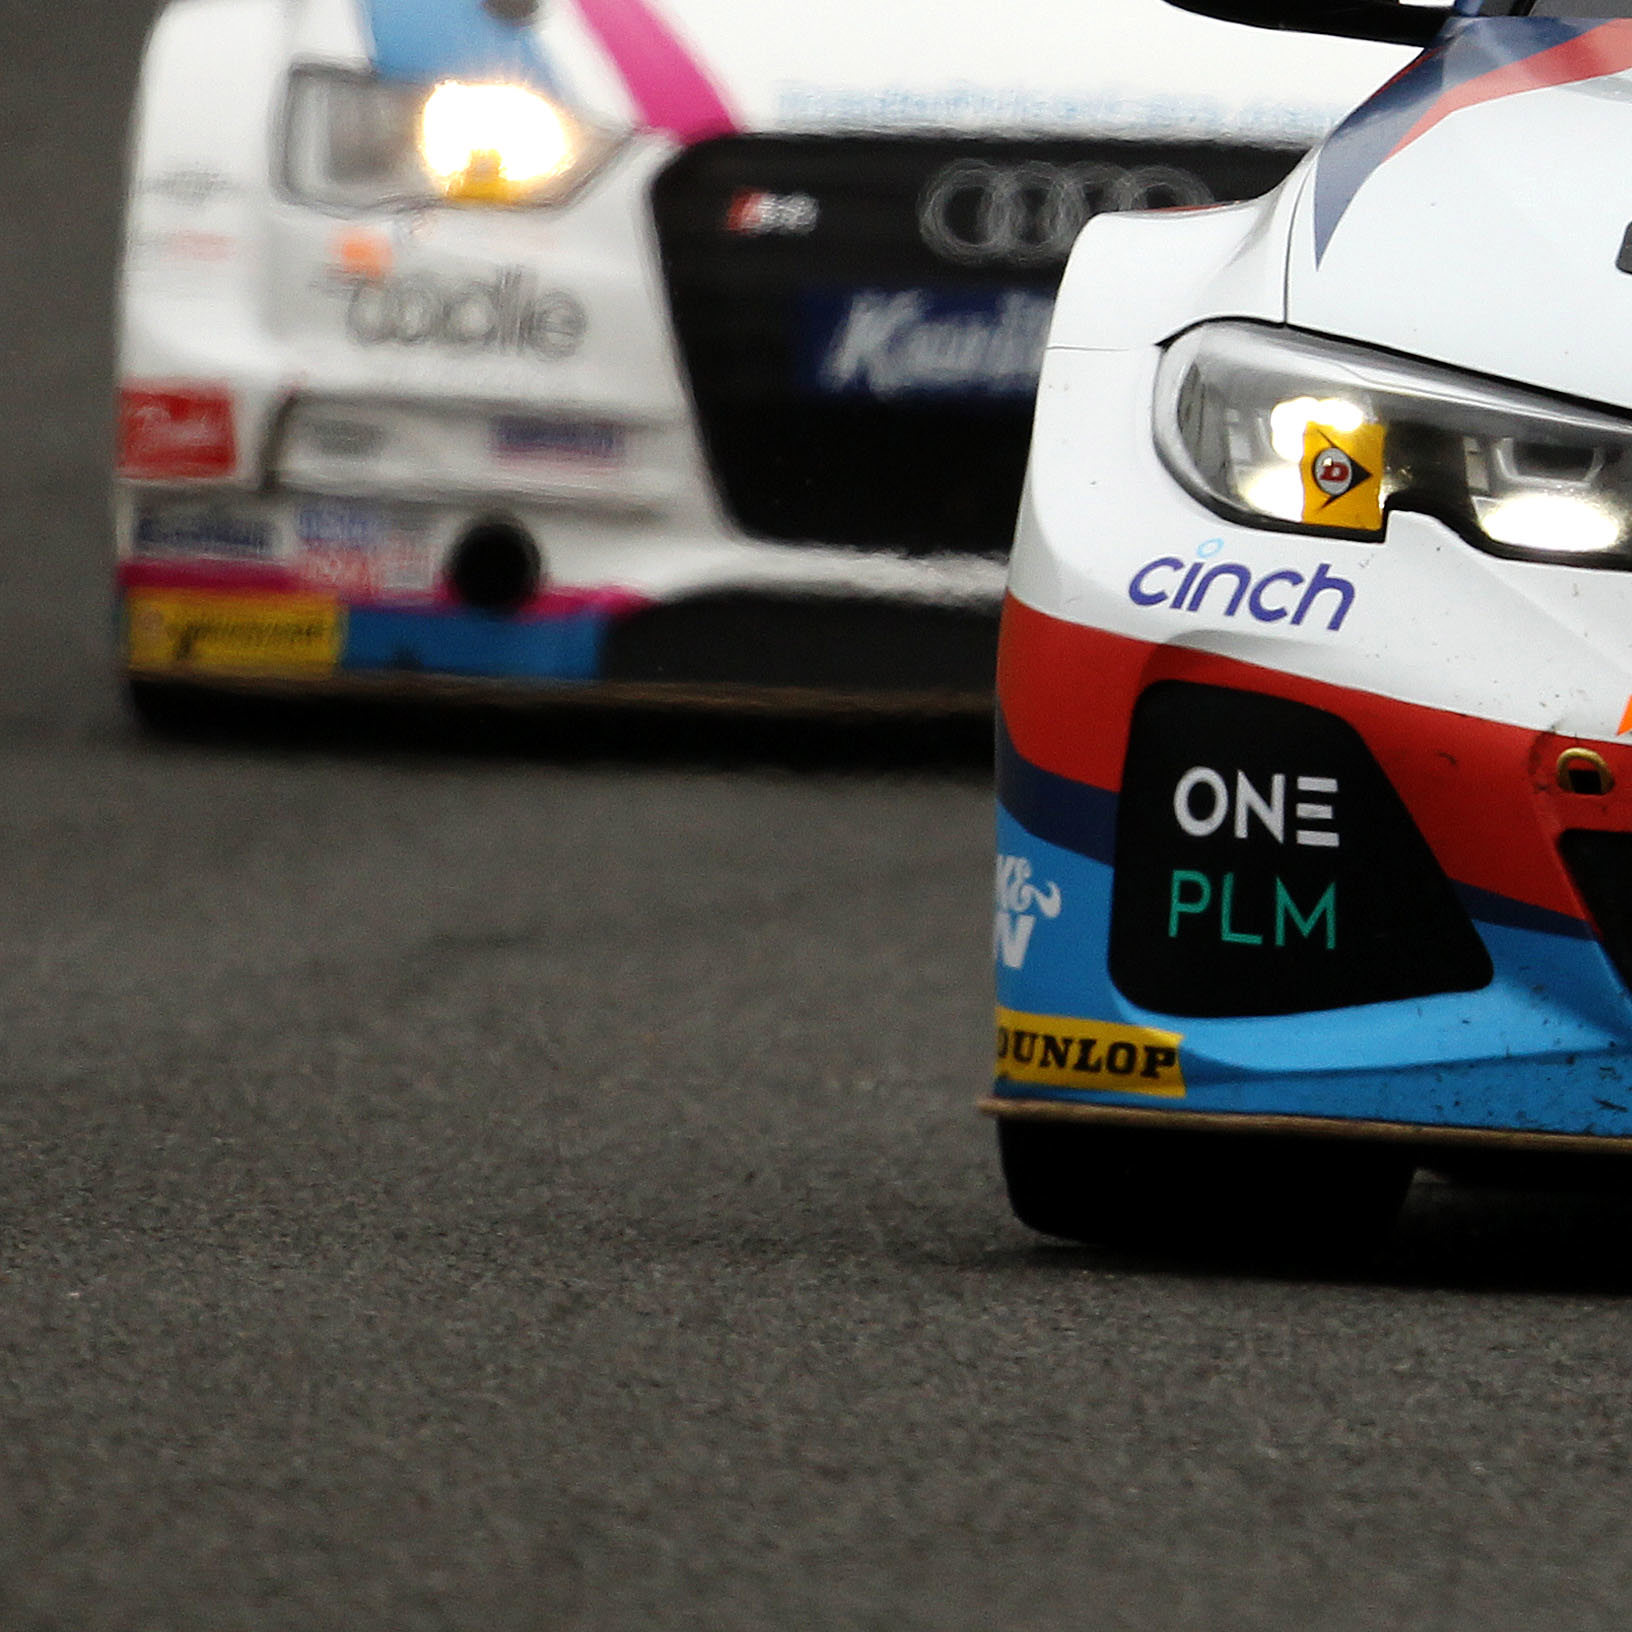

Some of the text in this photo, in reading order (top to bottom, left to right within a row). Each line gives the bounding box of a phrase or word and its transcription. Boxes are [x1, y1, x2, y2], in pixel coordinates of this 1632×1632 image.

[1127, 536, 1357, 632] cinch
[1172, 767, 1341, 849] ONE
[1168, 869, 1338, 951] PLM
